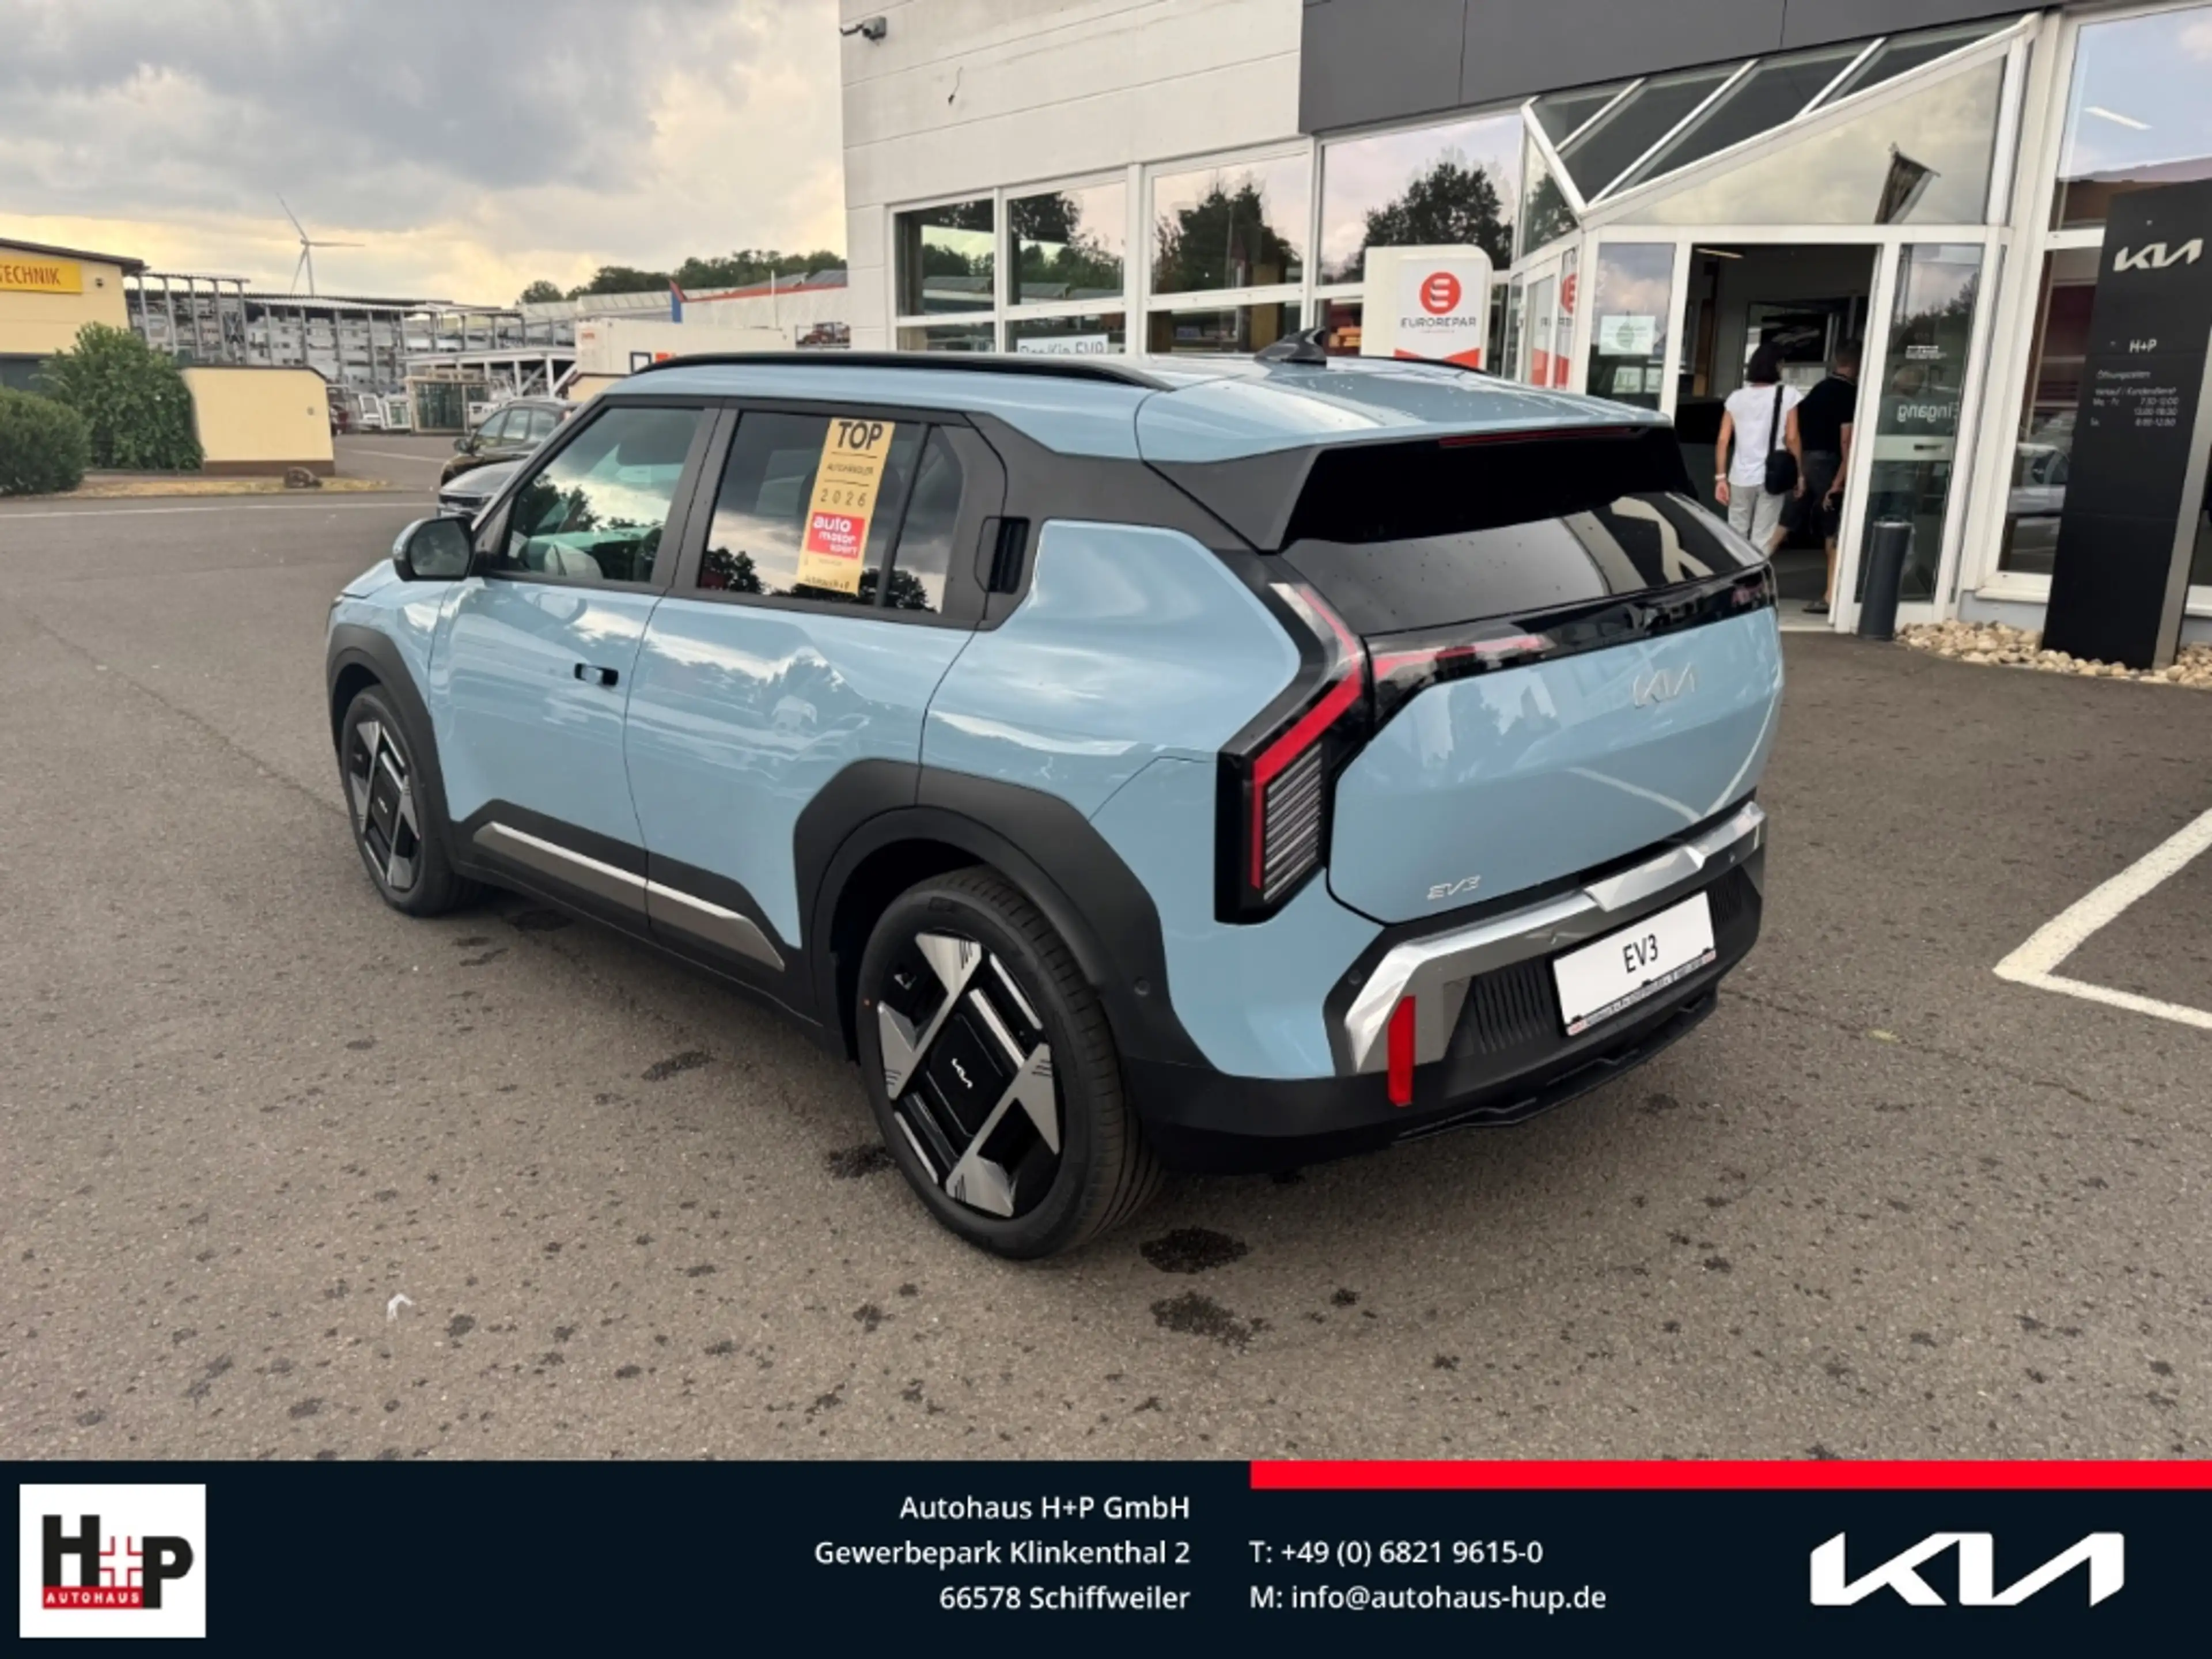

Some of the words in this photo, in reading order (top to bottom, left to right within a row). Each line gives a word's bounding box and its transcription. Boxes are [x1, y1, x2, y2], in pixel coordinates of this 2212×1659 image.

[837, 421, 884, 450] TOP
[813, 516, 852, 532] auto
[1427, 875, 1481, 900] EV3
[1623, 933, 1658, 974] EV3
